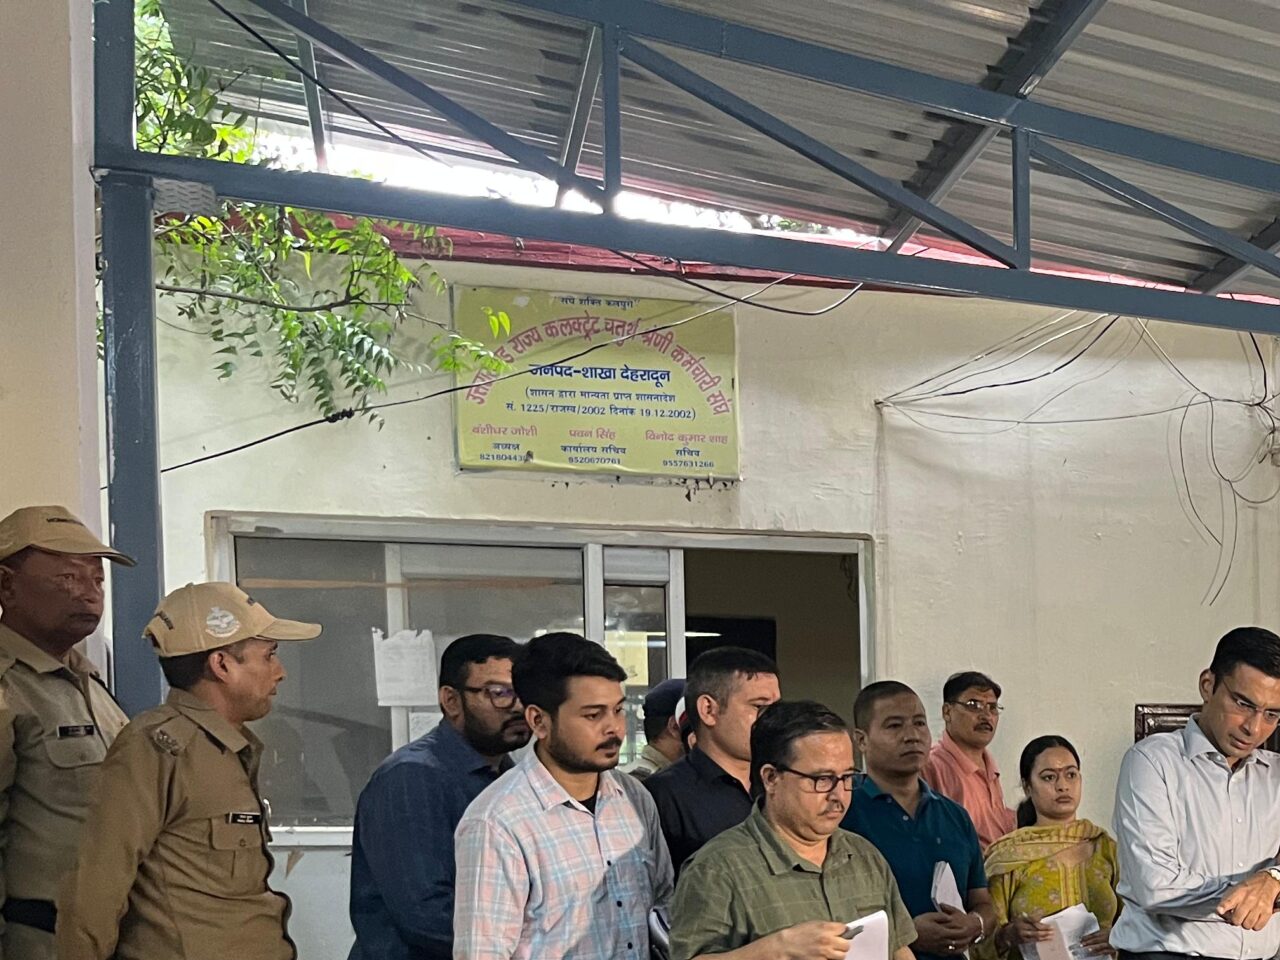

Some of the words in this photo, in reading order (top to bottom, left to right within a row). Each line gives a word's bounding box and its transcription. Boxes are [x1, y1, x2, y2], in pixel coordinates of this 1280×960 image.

[507, 326, 544, 354] राज्य
[604, 317, 641, 347] चतुर्थ
[671, 344, 722, 393] कर्मचारी
[706, 390, 732, 415] संघ
[620, 364, 671, 388] देहरादून
[558, 389, 576, 398] द्वारा
[580, 391, 609, 400] मान्यता
[613, 392, 632, 401] प्राप्त
[636, 392, 676, 403] शासनादेश
[609, 404, 635, 416] दिनांक
[512, 425, 538, 438] जोशी
[569, 428, 593, 439] पवन
[596, 427, 616, 441] सिंह
[645, 430, 675, 441] विनोद
[678, 432, 706, 446] कुमार
[560, 442, 597, 453] कार्यालय
[602, 444, 626, 454] सचिव
[676, 447, 700, 457] सचिव
